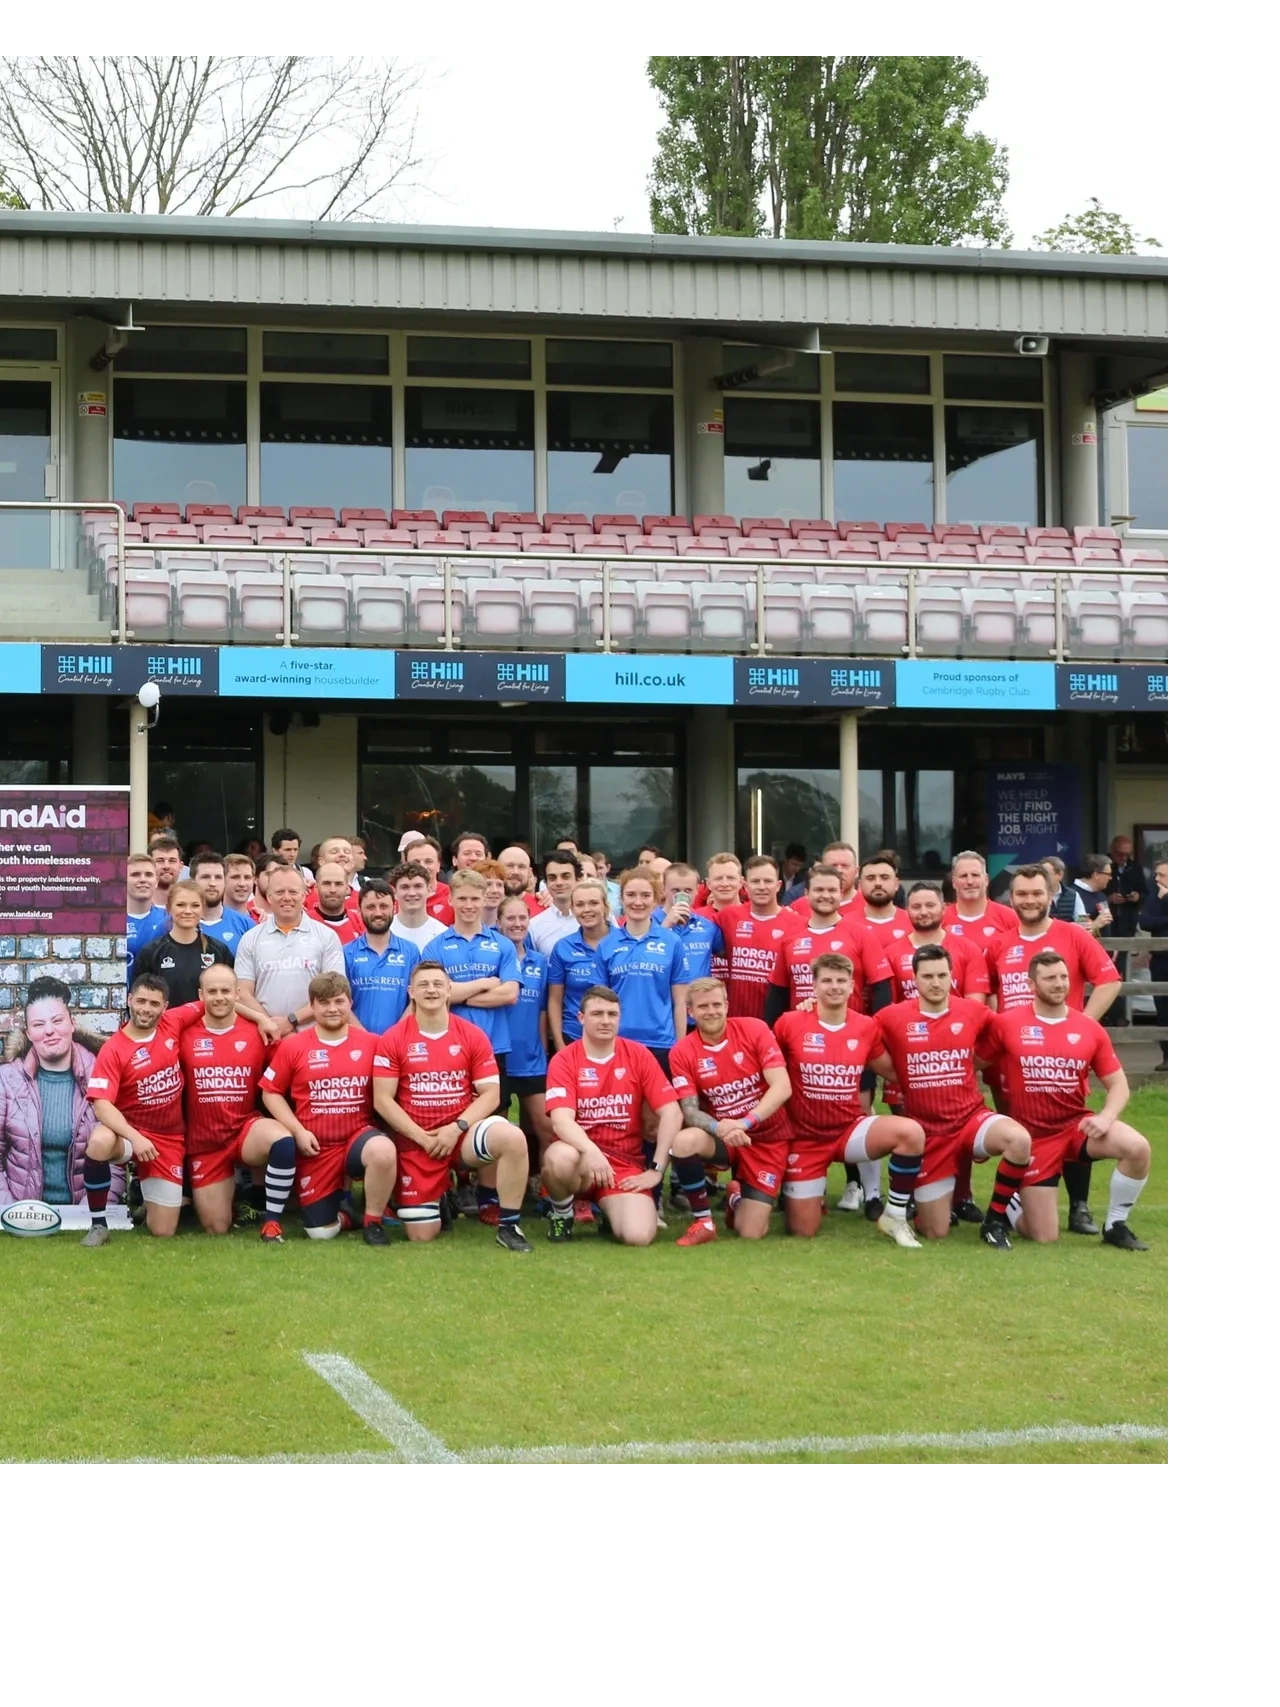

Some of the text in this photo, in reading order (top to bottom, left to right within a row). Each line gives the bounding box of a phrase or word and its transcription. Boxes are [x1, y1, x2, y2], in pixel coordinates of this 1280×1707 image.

[79, 656, 113, 674] Hill
[168, 657, 201, 675] Hill
[280, 660, 335, 671] A five-star,
[431, 662, 464, 680] Hill
[517, 664, 549, 682] Hill
[615, 671, 686, 687] hill.co.uk
[768, 668, 799, 686] Hill
[849, 670, 881, 688] Hill
[932, 673, 1019, 684] Proud sponsors of
[58, 674, 113, 687] Created for Living
[234, 674, 380, 687] award-winning housebuilder
[412, 680, 464, 693] Created for Living
[1088, 674, 1119, 692] Hill
[749, 686, 800, 698] Created for Living
[922, 685, 1031, 698] Cambridge Rugby Club
[997, 789, 1048, 800] WE HELP
[997, 801, 1052, 811] YOU FIND
[997, 812, 1058, 823] THE RIGHT
[1025, 823, 1058, 834] RIGHT
[997, 835, 1027, 846] NOW
[16, 844, 32, 852] we
[33, 844, 51, 852] can
[22, 856, 91, 866] homelessness
[18, 877, 47, 885] property
[48, 876, 75, 885] industry
[76, 876, 101, 884] charity,
[690, 942, 711, 950] REEVE
[444, 963, 497, 974] MILLS REEVE
[640, 962, 665, 973] REEVE
[381, 976, 405, 987] REEVE
[521, 988, 540, 997] REEV
[907, 1048, 969, 1064] MORGAN
[1020, 1056, 1086, 1069] MORGAN
[136, 1059, 181, 1087] MORGA
[193, 1066, 252, 1079] MORGAN
[799, 1062, 864, 1075] MORGAN
[907, 1061, 965, 1075] SINDALL
[1022, 1067, 1079, 1079] SINDALL
[408, 1069, 467, 1083] MORGAN
[801, 1073, 857, 1087] SINDALL
[137, 1072, 181, 1096] SINDALL
[195, 1077, 248, 1089] SINDALL
[309, 1075, 369, 1091] MORGAN
[409, 1080, 464, 1093] SINDALL
[702, 1072, 760, 1098] MORGAN
[909, 1078, 963, 1089] CONSTRUCTION
[198, 1095, 244, 1104] CONSTRUCTION
[309, 1087, 364, 1100] SINDALL
[803, 1090, 853, 1101] CONSTRUCTION
[410, 1098, 460, 1107] CONSTRUCTION
[577, 1093, 633, 1109] MORGAN
[310, 1106, 360, 1115] CONSTRUCTION
[578, 1105, 629, 1119] SINDALL
[7, 1211, 55, 1222] GILBERT
